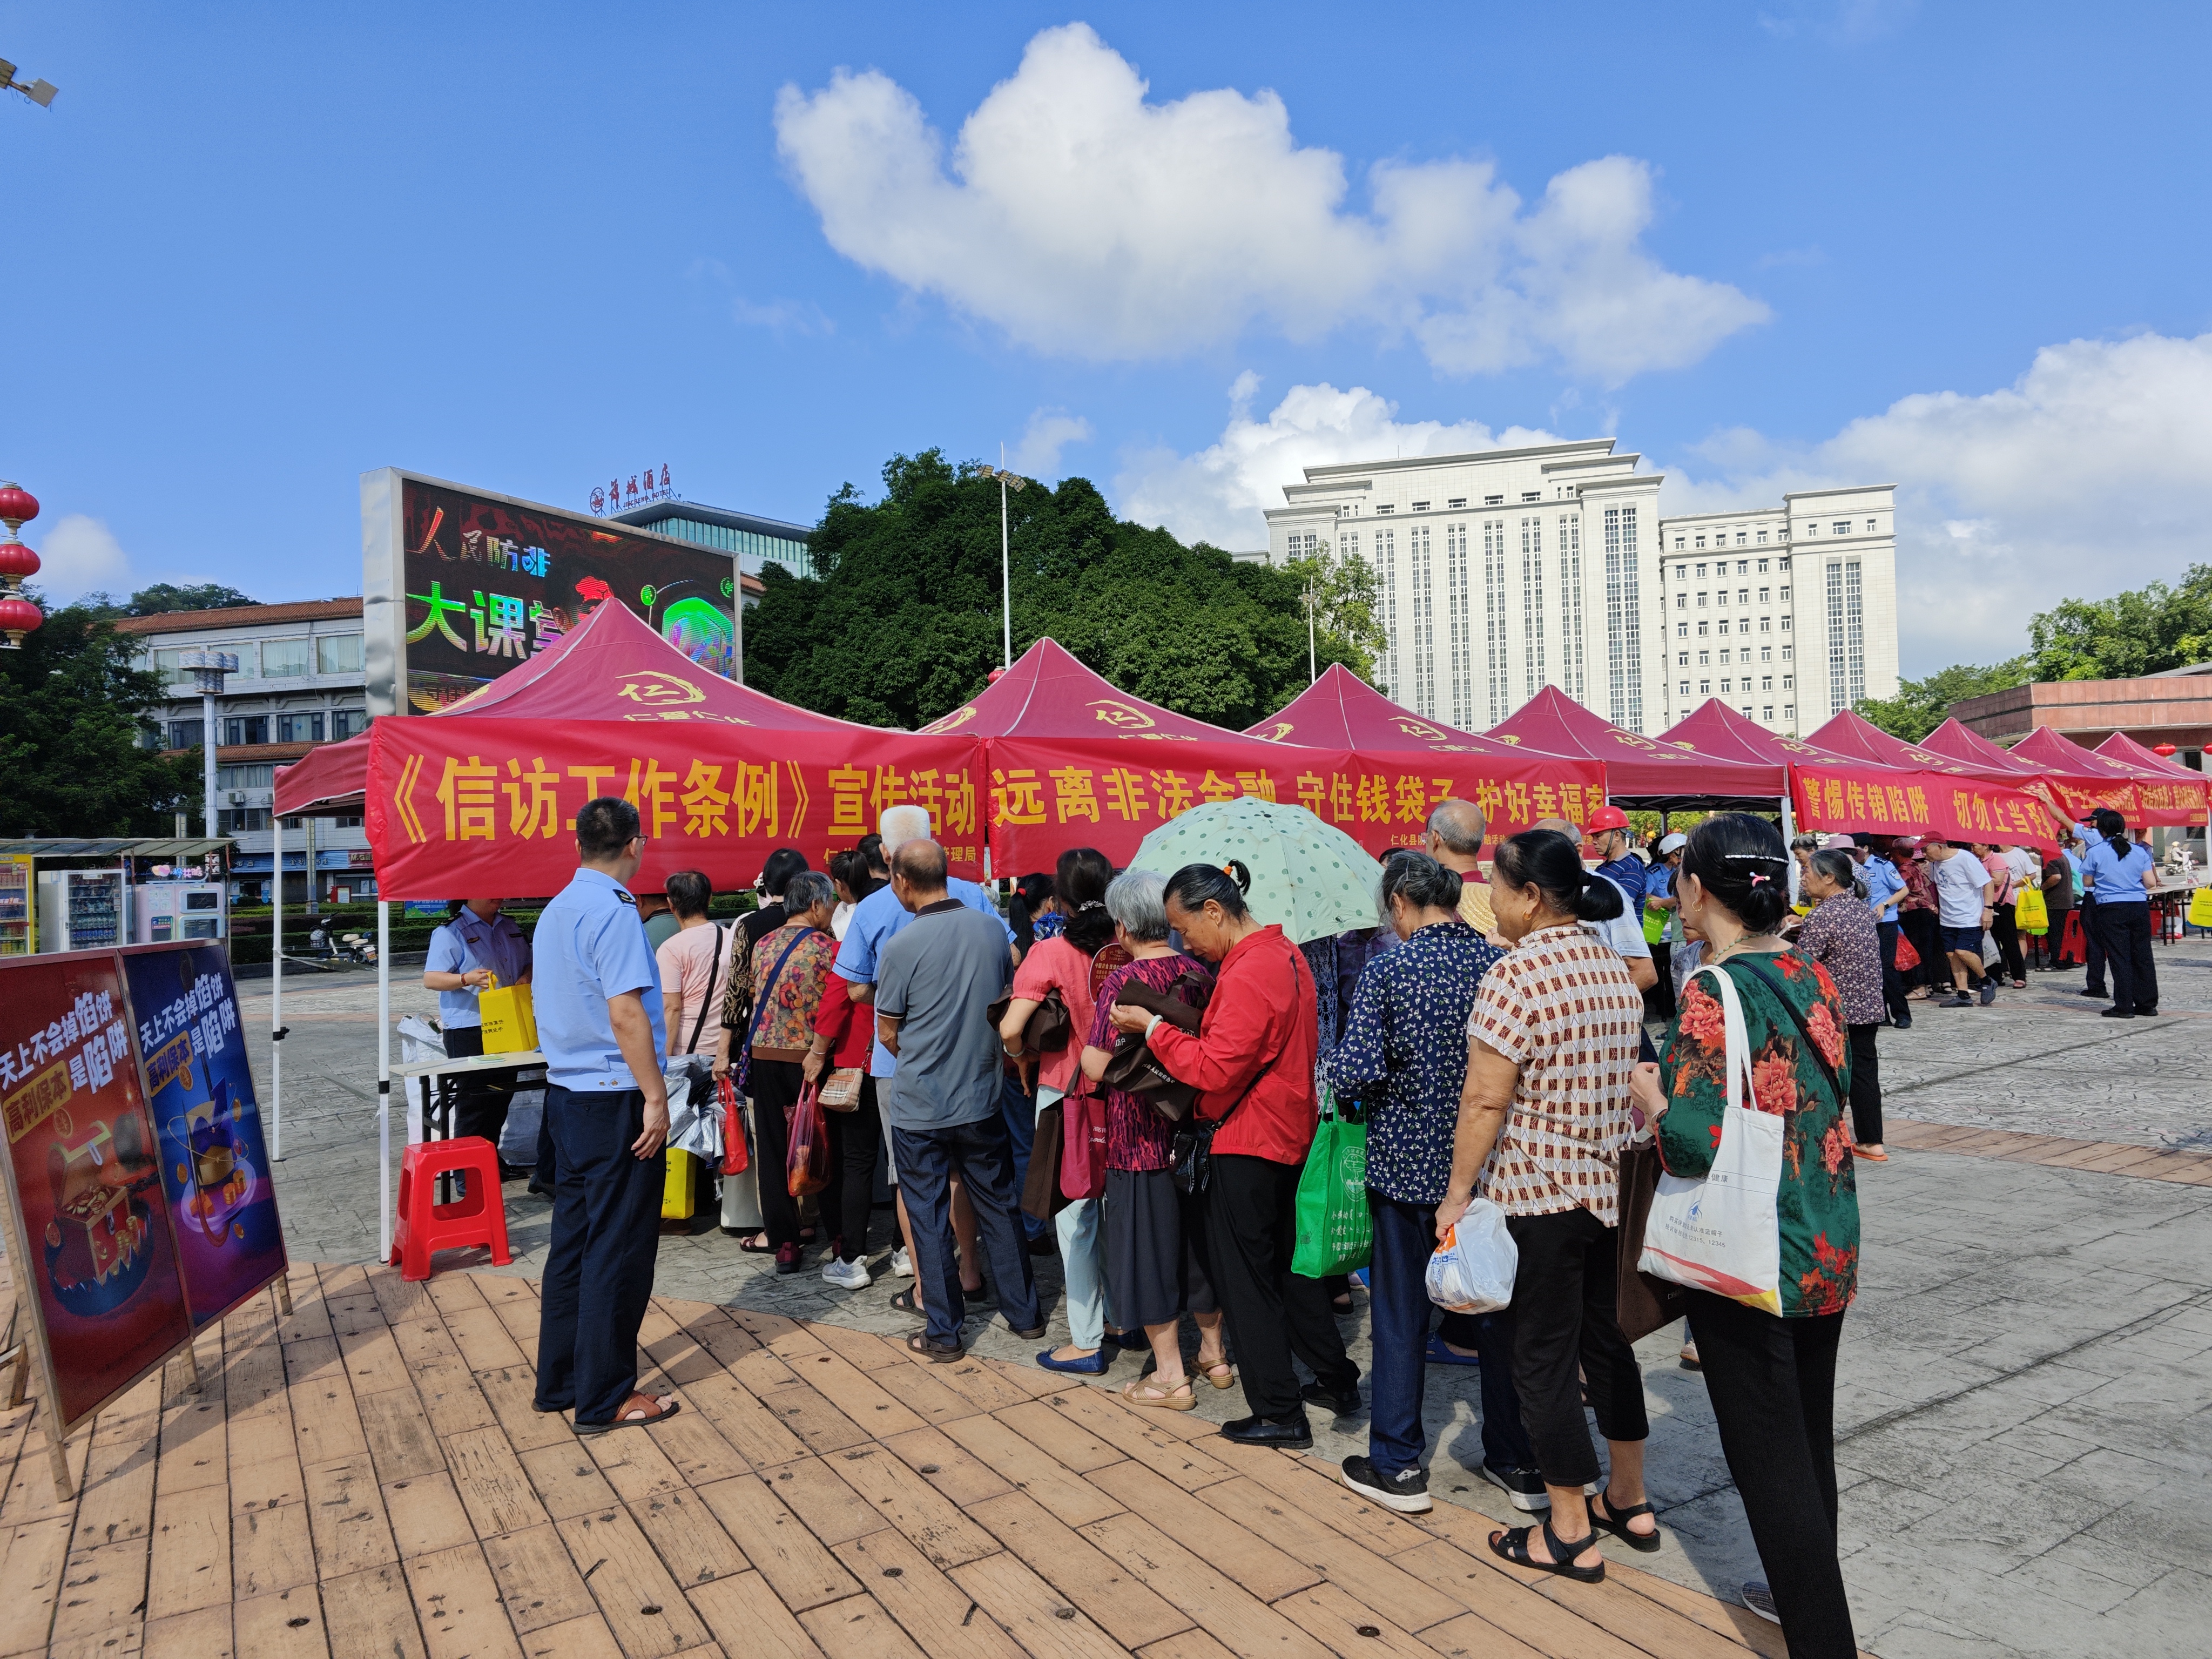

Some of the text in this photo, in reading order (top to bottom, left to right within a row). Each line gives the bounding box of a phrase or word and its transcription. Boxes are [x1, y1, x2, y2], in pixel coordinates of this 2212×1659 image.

[991, 765, 1604, 827] 远离非法金融 守住钱袋子 护好幸福家
[1802, 777, 1930, 825] 警惕传销陷阱
[0, 990, 112, 1091] 天上不会掉馅饼
[140, 973, 224, 1054] 天上不会掉馅饼
[191, 997, 236, 1060] 是陷阱
[5, 1022, 129, 1134] 高利保本 是陷阱
